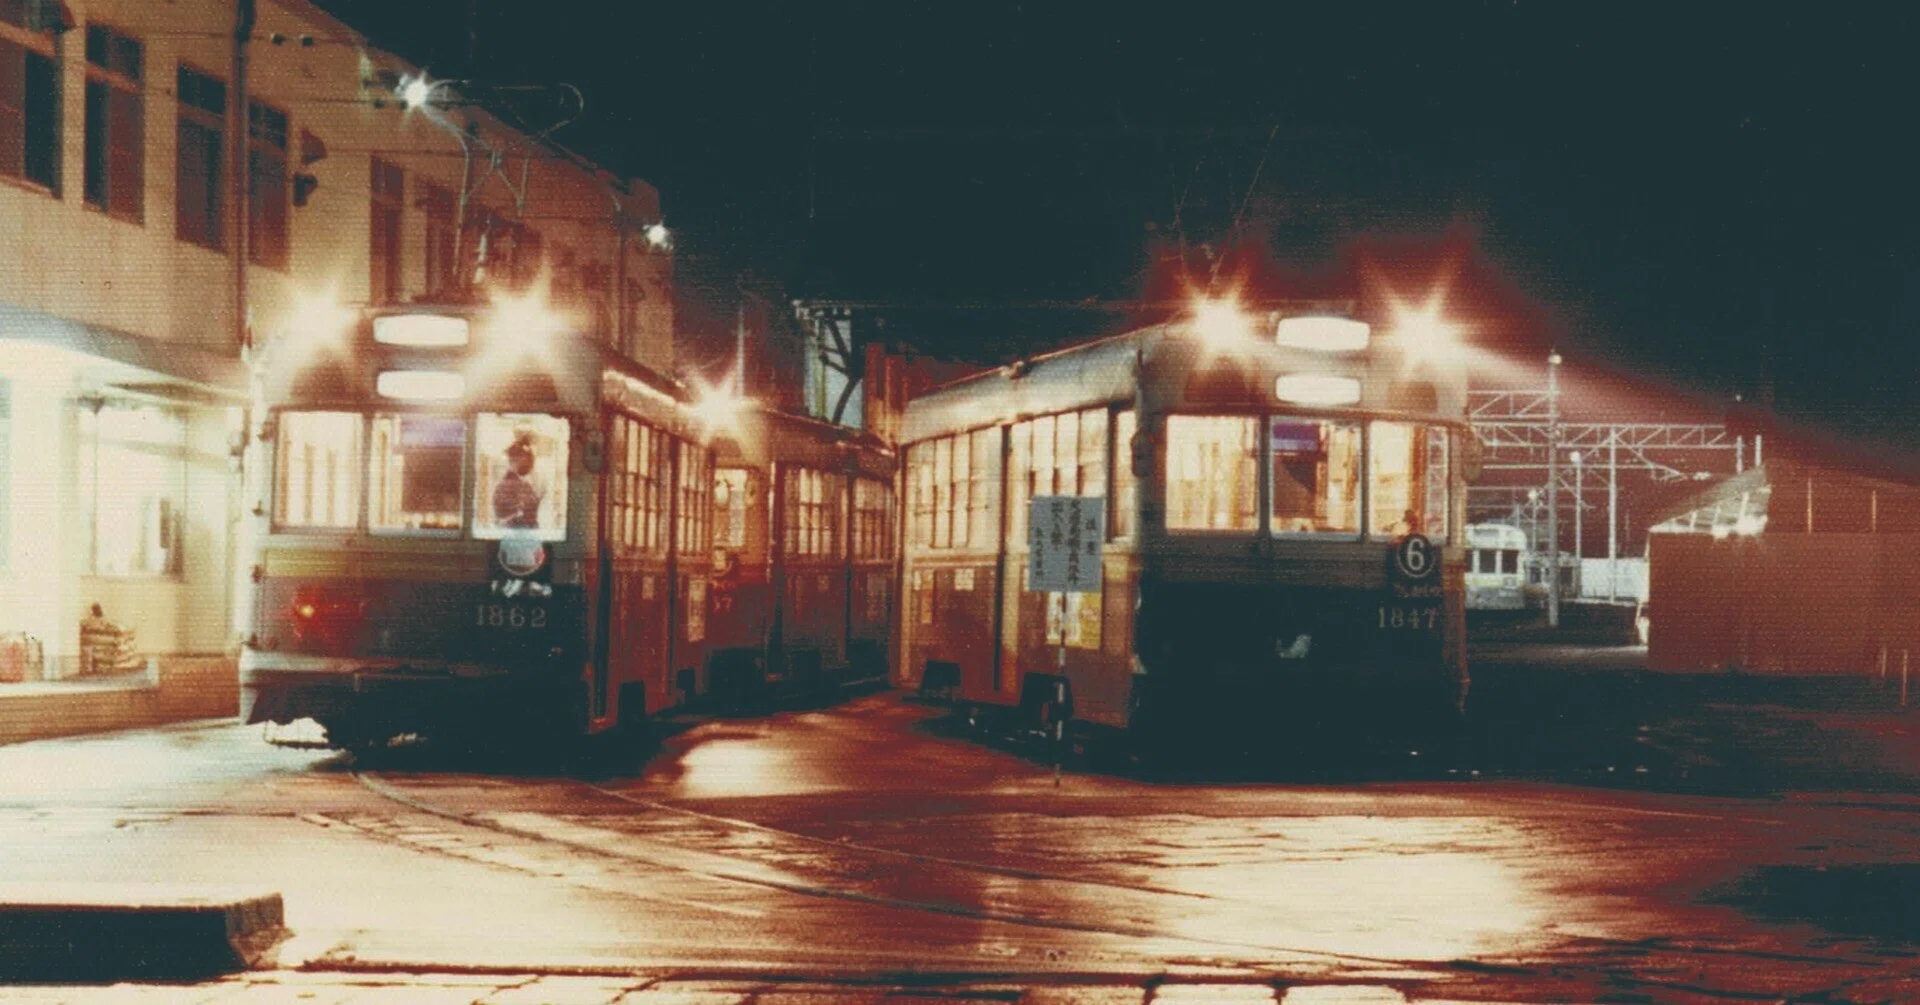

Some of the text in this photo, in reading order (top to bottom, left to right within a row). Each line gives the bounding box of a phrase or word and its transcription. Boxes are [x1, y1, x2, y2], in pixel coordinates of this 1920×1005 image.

[1407, 538, 1425, 571] 6
[476, 603, 547, 628] 1862
[1378, 607, 1438, 630] 1847
